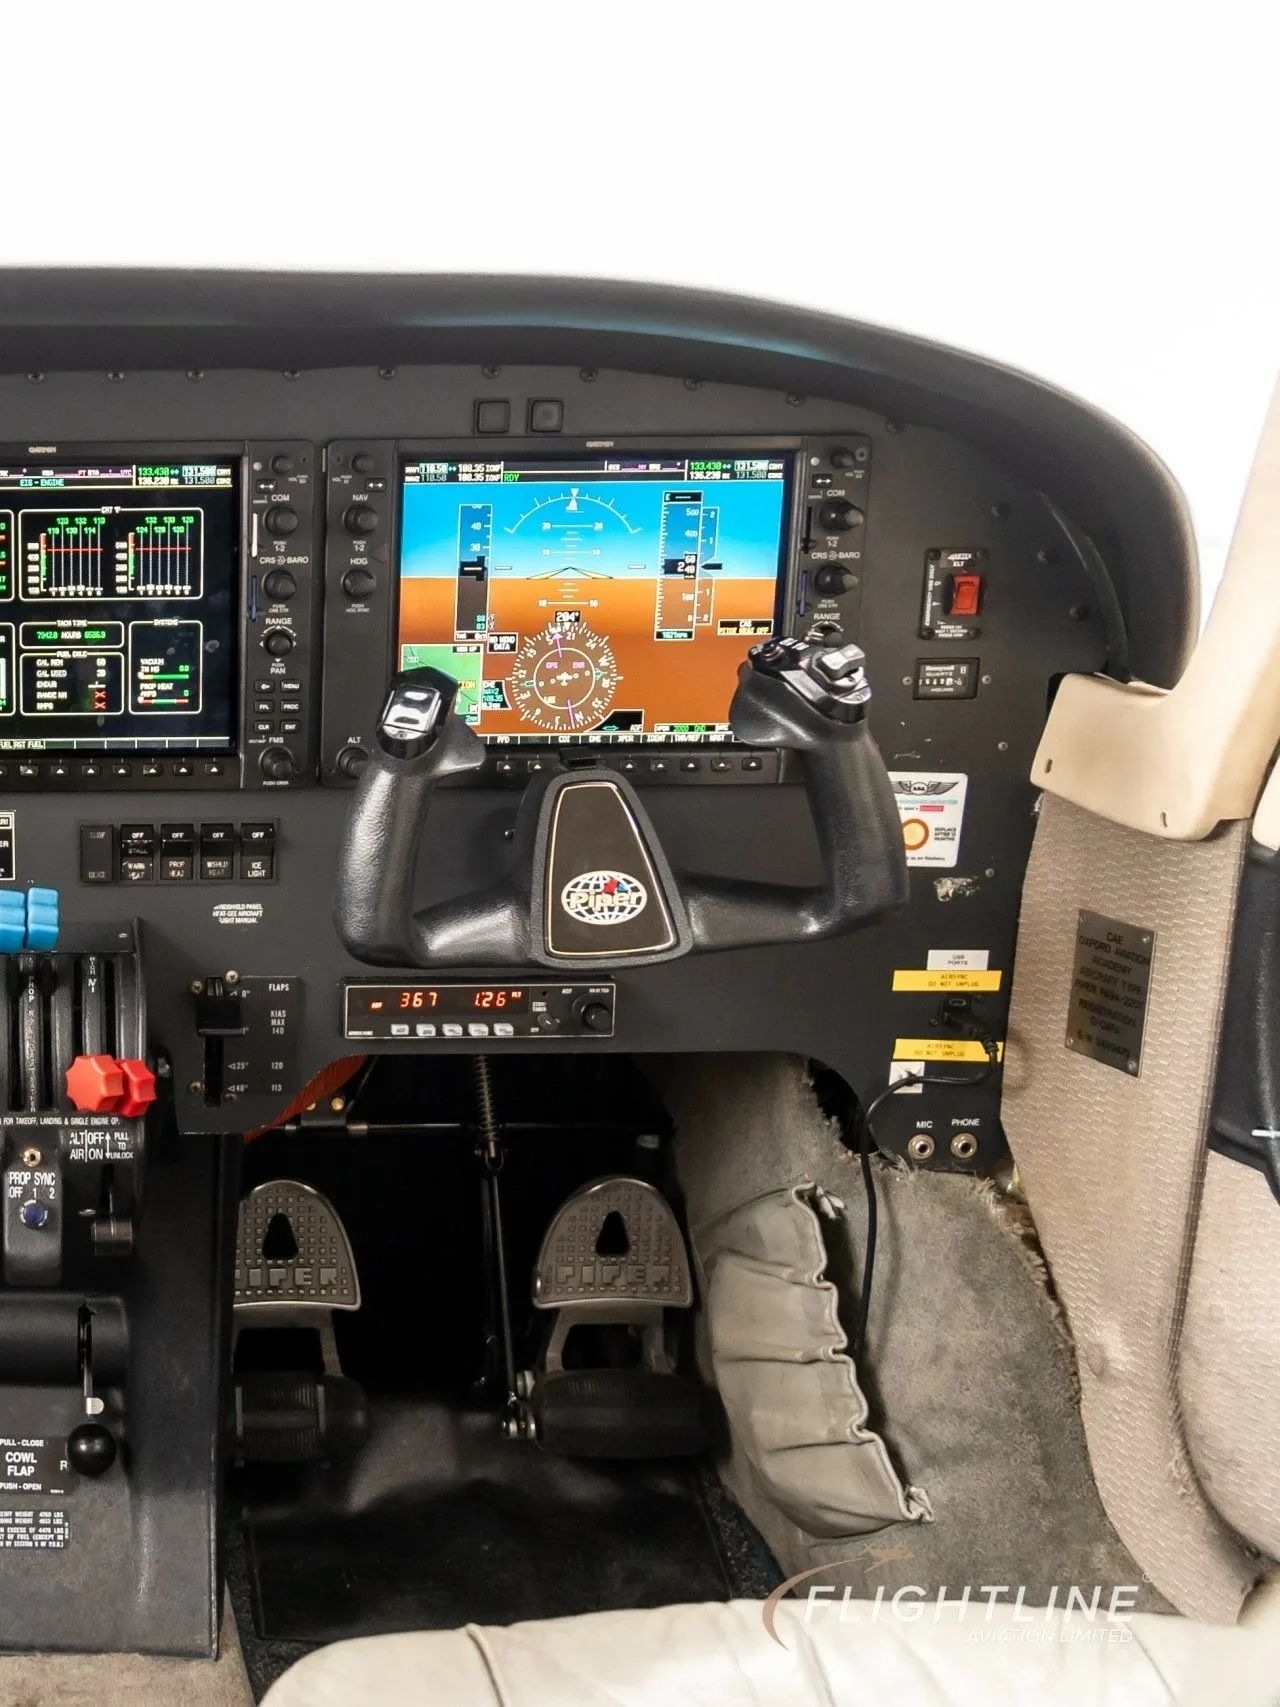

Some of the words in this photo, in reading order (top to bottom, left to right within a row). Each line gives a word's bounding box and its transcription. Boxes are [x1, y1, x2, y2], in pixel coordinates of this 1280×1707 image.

[569, 891, 642, 912] Piper
[400, 992, 437, 1008] 367
[16, 1117, 38, 1125] TAKEOFF,
[40, 1117, 62, 1125] LANDING
[71, 1117, 88, 1125] SINGLE
[91, 1117, 109, 1125] ENGINE
[111, 1117, 120, 1125] OP.
[952, 1119, 979, 1127] PHONE
[70, 1132, 85, 1144] ALT
[88, 1132, 104, 1144] OFF
[115, 1132, 129, 1140] PULL
[118, 1142, 126, 1150] TO
[70, 1149, 84, 1159] AIR
[89, 1149, 103, 1159] ON
[9, 1172, 30, 1185] PROP
[34, 1173, 55, 1185] SYNC
[9, 1187, 23, 1198] OFF
[32, 1187, 37, 1198] 1
[50, 1187, 54, 1199] 2
[555, 1265, 671, 1284] PIPER
[22, 1439, 44, 1447] CLOSE
[6, 1452, 37, 1463] COWL
[60, 1461, 67, 1470] R
[8, 1466, 34, 1476] FLAP
[0, 1482, 17, 1490] PUSH
